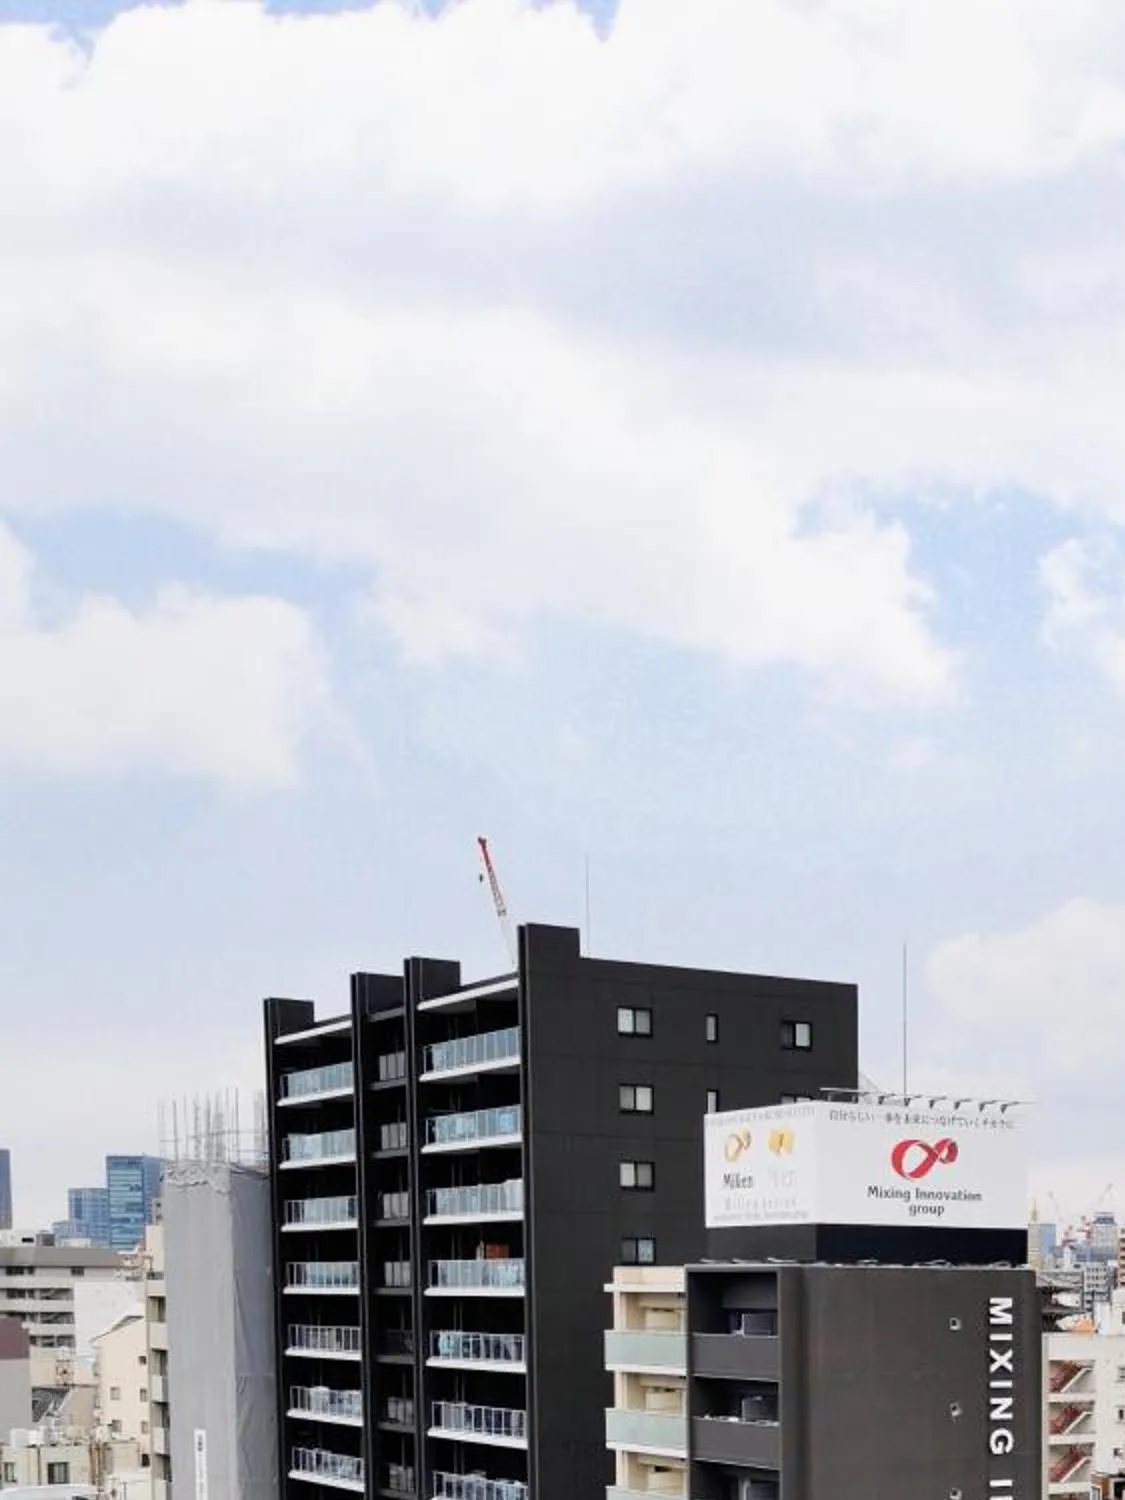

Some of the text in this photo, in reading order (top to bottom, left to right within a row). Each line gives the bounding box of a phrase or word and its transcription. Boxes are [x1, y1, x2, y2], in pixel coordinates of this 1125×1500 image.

[867, 1186, 982, 1202] Mixing Innovation
[908, 1203, 945, 1216] group
[989, 1297, 1014, 1454] MIXING
